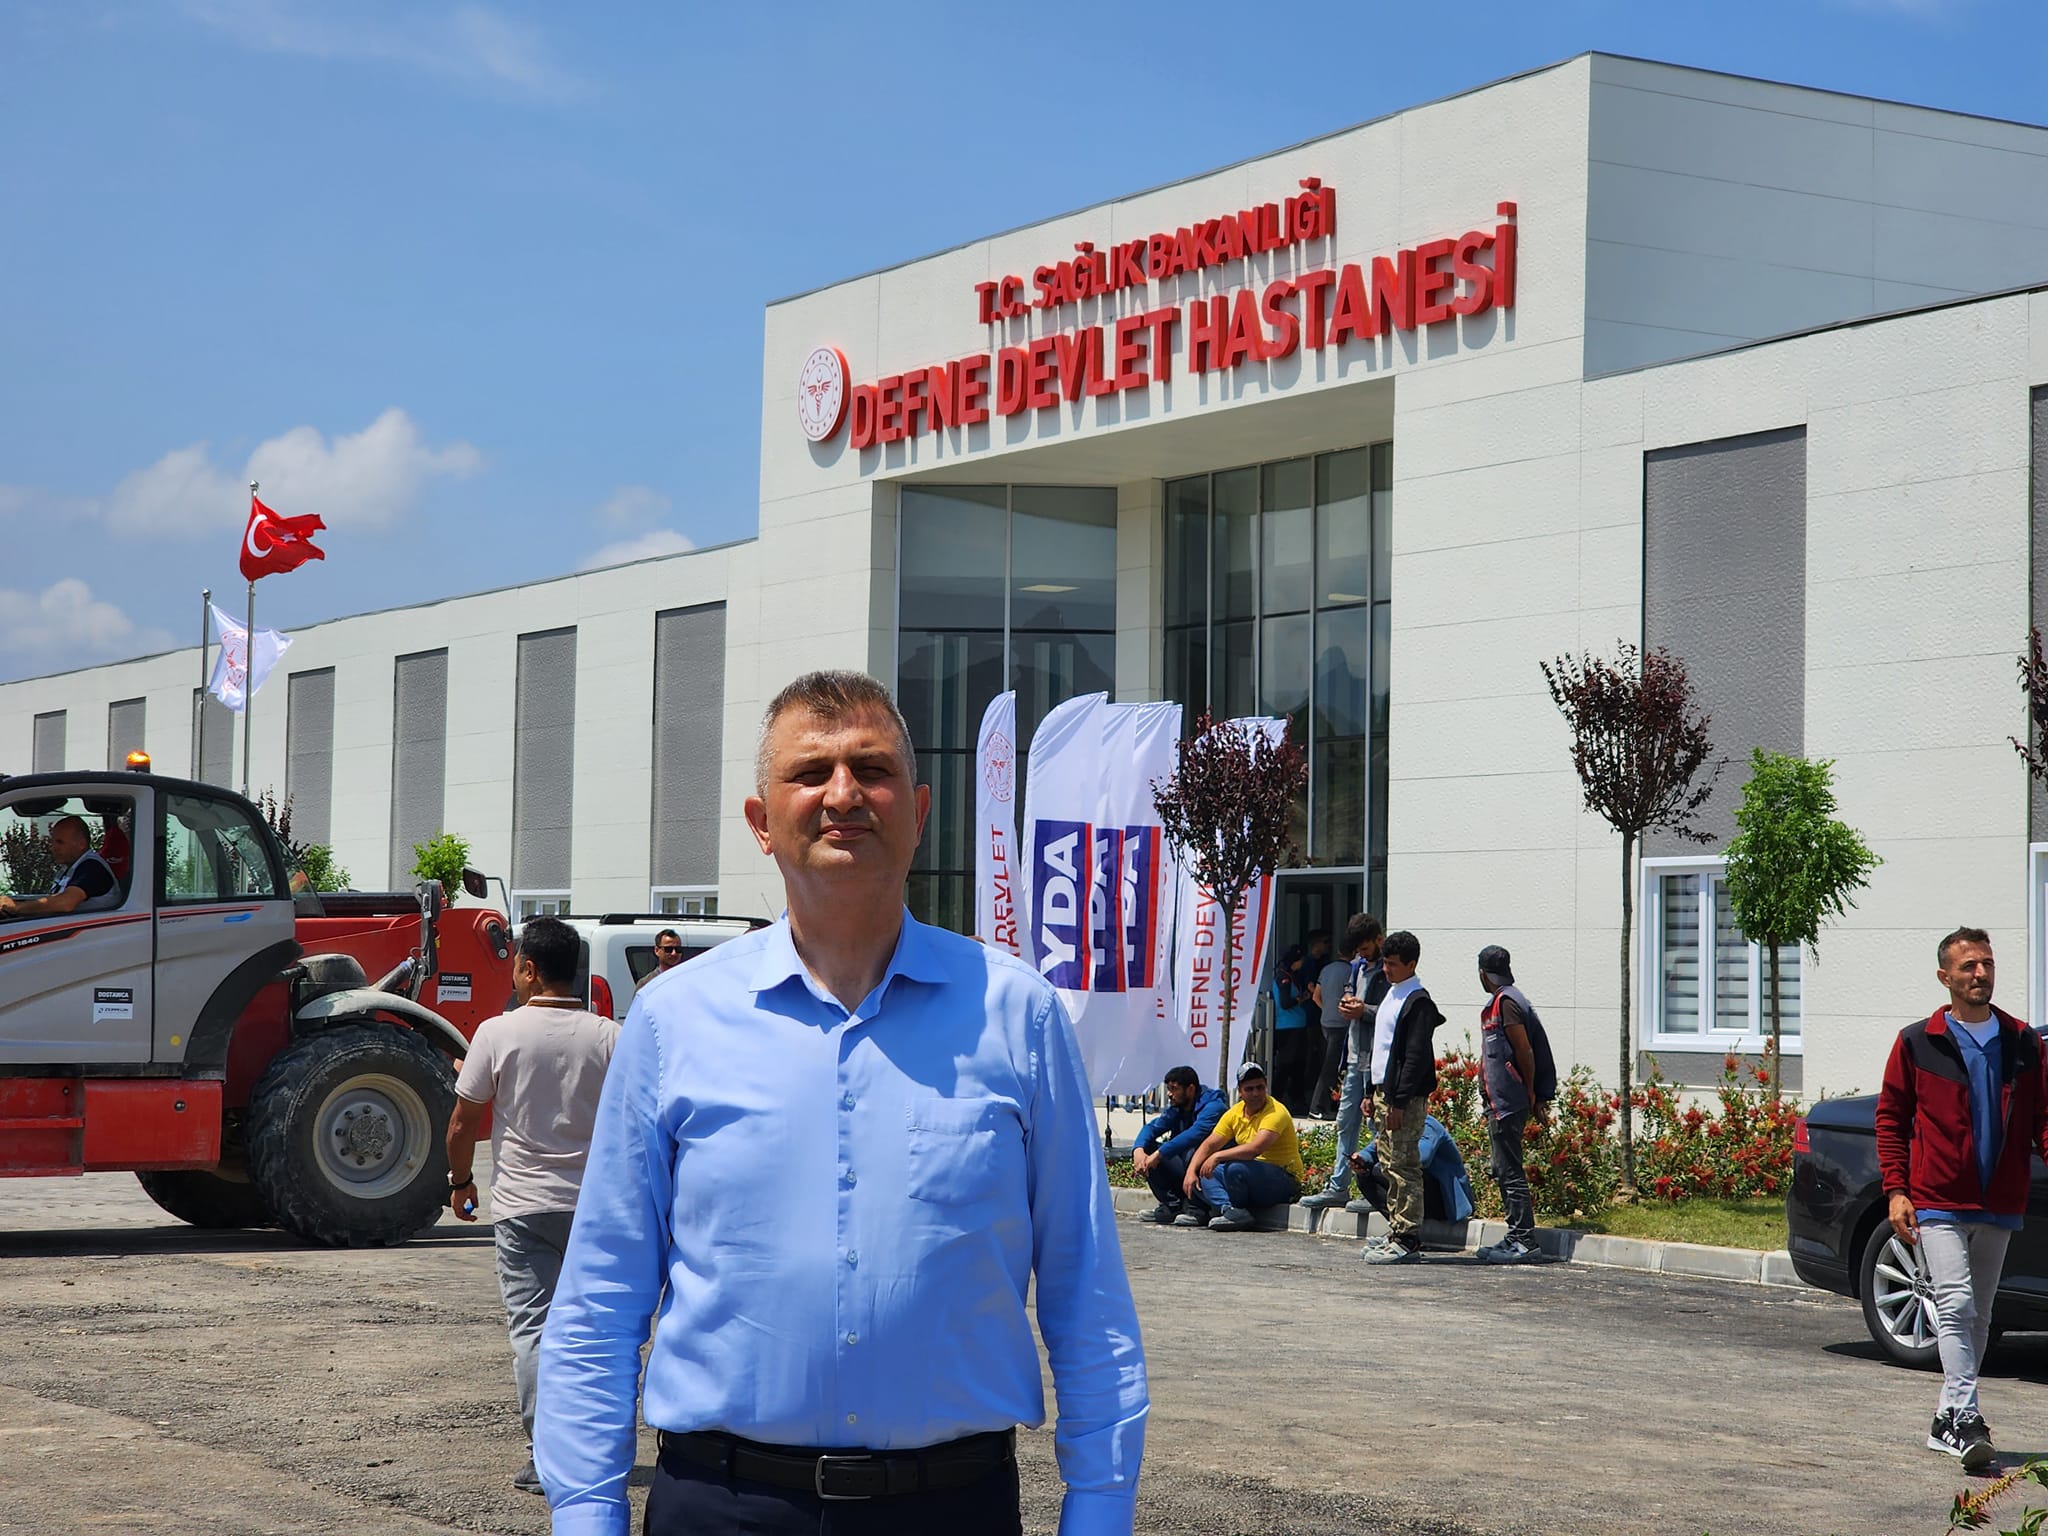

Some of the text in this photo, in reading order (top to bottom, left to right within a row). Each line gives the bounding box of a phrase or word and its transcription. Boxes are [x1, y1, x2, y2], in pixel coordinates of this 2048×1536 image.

[975, 177, 1336, 325] T.C. SAĞLIK BAKANLIĞİ
[850, 201, 1517, 451] DEFNE DEVLET HASTANESİ
[1040, 831, 1079, 976] YDA
[1190, 957, 1212, 1048] DEFNE
